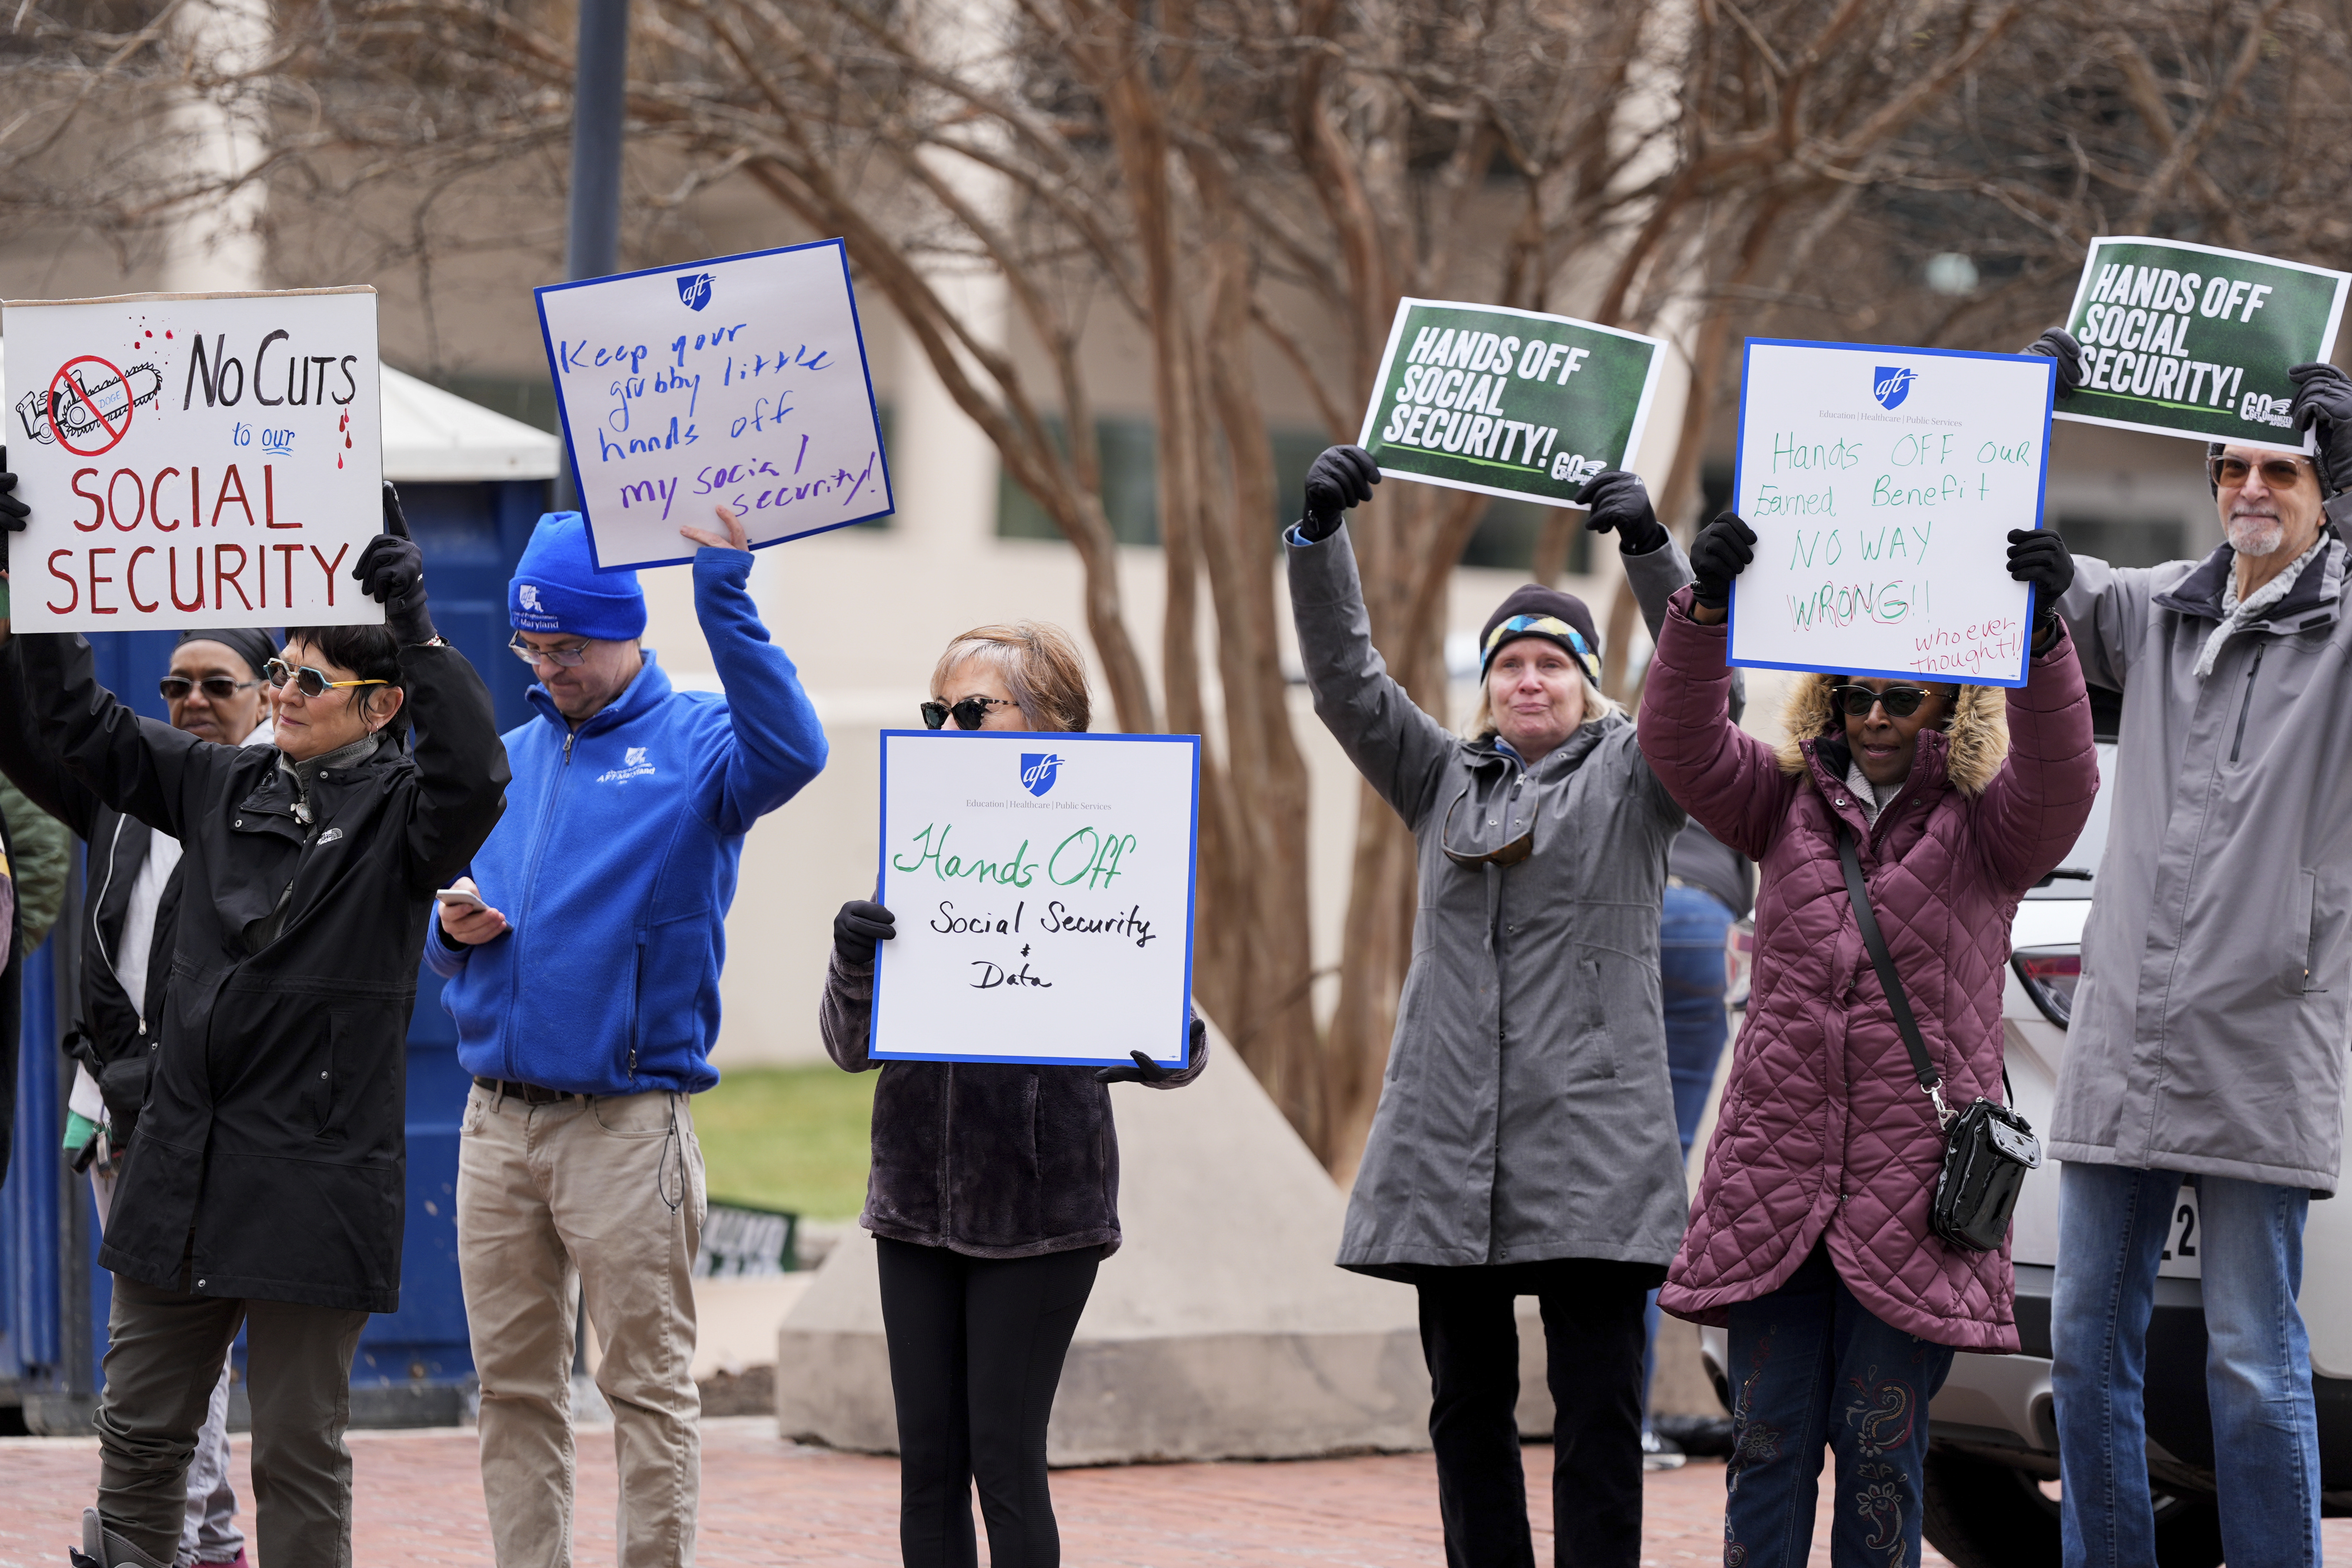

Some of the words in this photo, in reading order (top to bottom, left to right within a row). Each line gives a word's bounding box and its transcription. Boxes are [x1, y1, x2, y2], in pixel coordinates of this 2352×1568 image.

[683, 273, 716, 308] aft
[2089, 264, 2201, 314] HANDS
[2200, 277, 2272, 323] OFF
[560, 340, 648, 374] Keep
[671, 324, 746, 367] your
[2079, 303, 2190, 357] SOCIAL
[1406, 326, 1520, 375] HANDS
[1517, 340, 1590, 385] OFF
[2078, 345, 2244, 408] SECURITY!
[98, 390, 122, 409] DOGE
[610, 366, 700, 432] grubby
[725, 345, 835, 386] little
[1396, 365, 1508, 416] SOCIAL
[1876, 367, 1918, 404] aft
[233, 422, 252, 446] to
[262, 429, 295, 448] our
[599, 417, 699, 462] hands
[731, 391, 794, 438] off
[1383, 403, 1558, 467] SECURITY!
[1819, 410, 1855, 419] Education
[1861, 413, 1901, 422] Healthcare
[1906, 416, 1929, 424] Public
[1932, 418, 1962, 427] Services
[621, 477, 678, 520] my
[693, 434, 809, 495] social
[1773, 431, 1862, 473] Hands
[1892, 433, 1953, 466] OFF
[72, 464, 303, 533] SOCIAL
[733, 452, 876, 518] security!
[1754, 484, 1836, 517] Earned
[1872, 473, 1989, 506] Benefit
[1791, 530, 1839, 570] NO
[1861, 521, 1930, 565] WAY
[47, 543, 349, 615] SECURITY
[1910, 630, 2022, 675] thought!!
[1023, 753, 1066, 791] aft
[1010, 800, 1050, 809] Healthcare
[894, 823, 1039, 888] Hands
[1049, 826, 1136, 890] Off
[931, 901, 1024, 935] Social
[1041, 901, 1156, 948] Security
[969, 961, 1052, 989] Data
